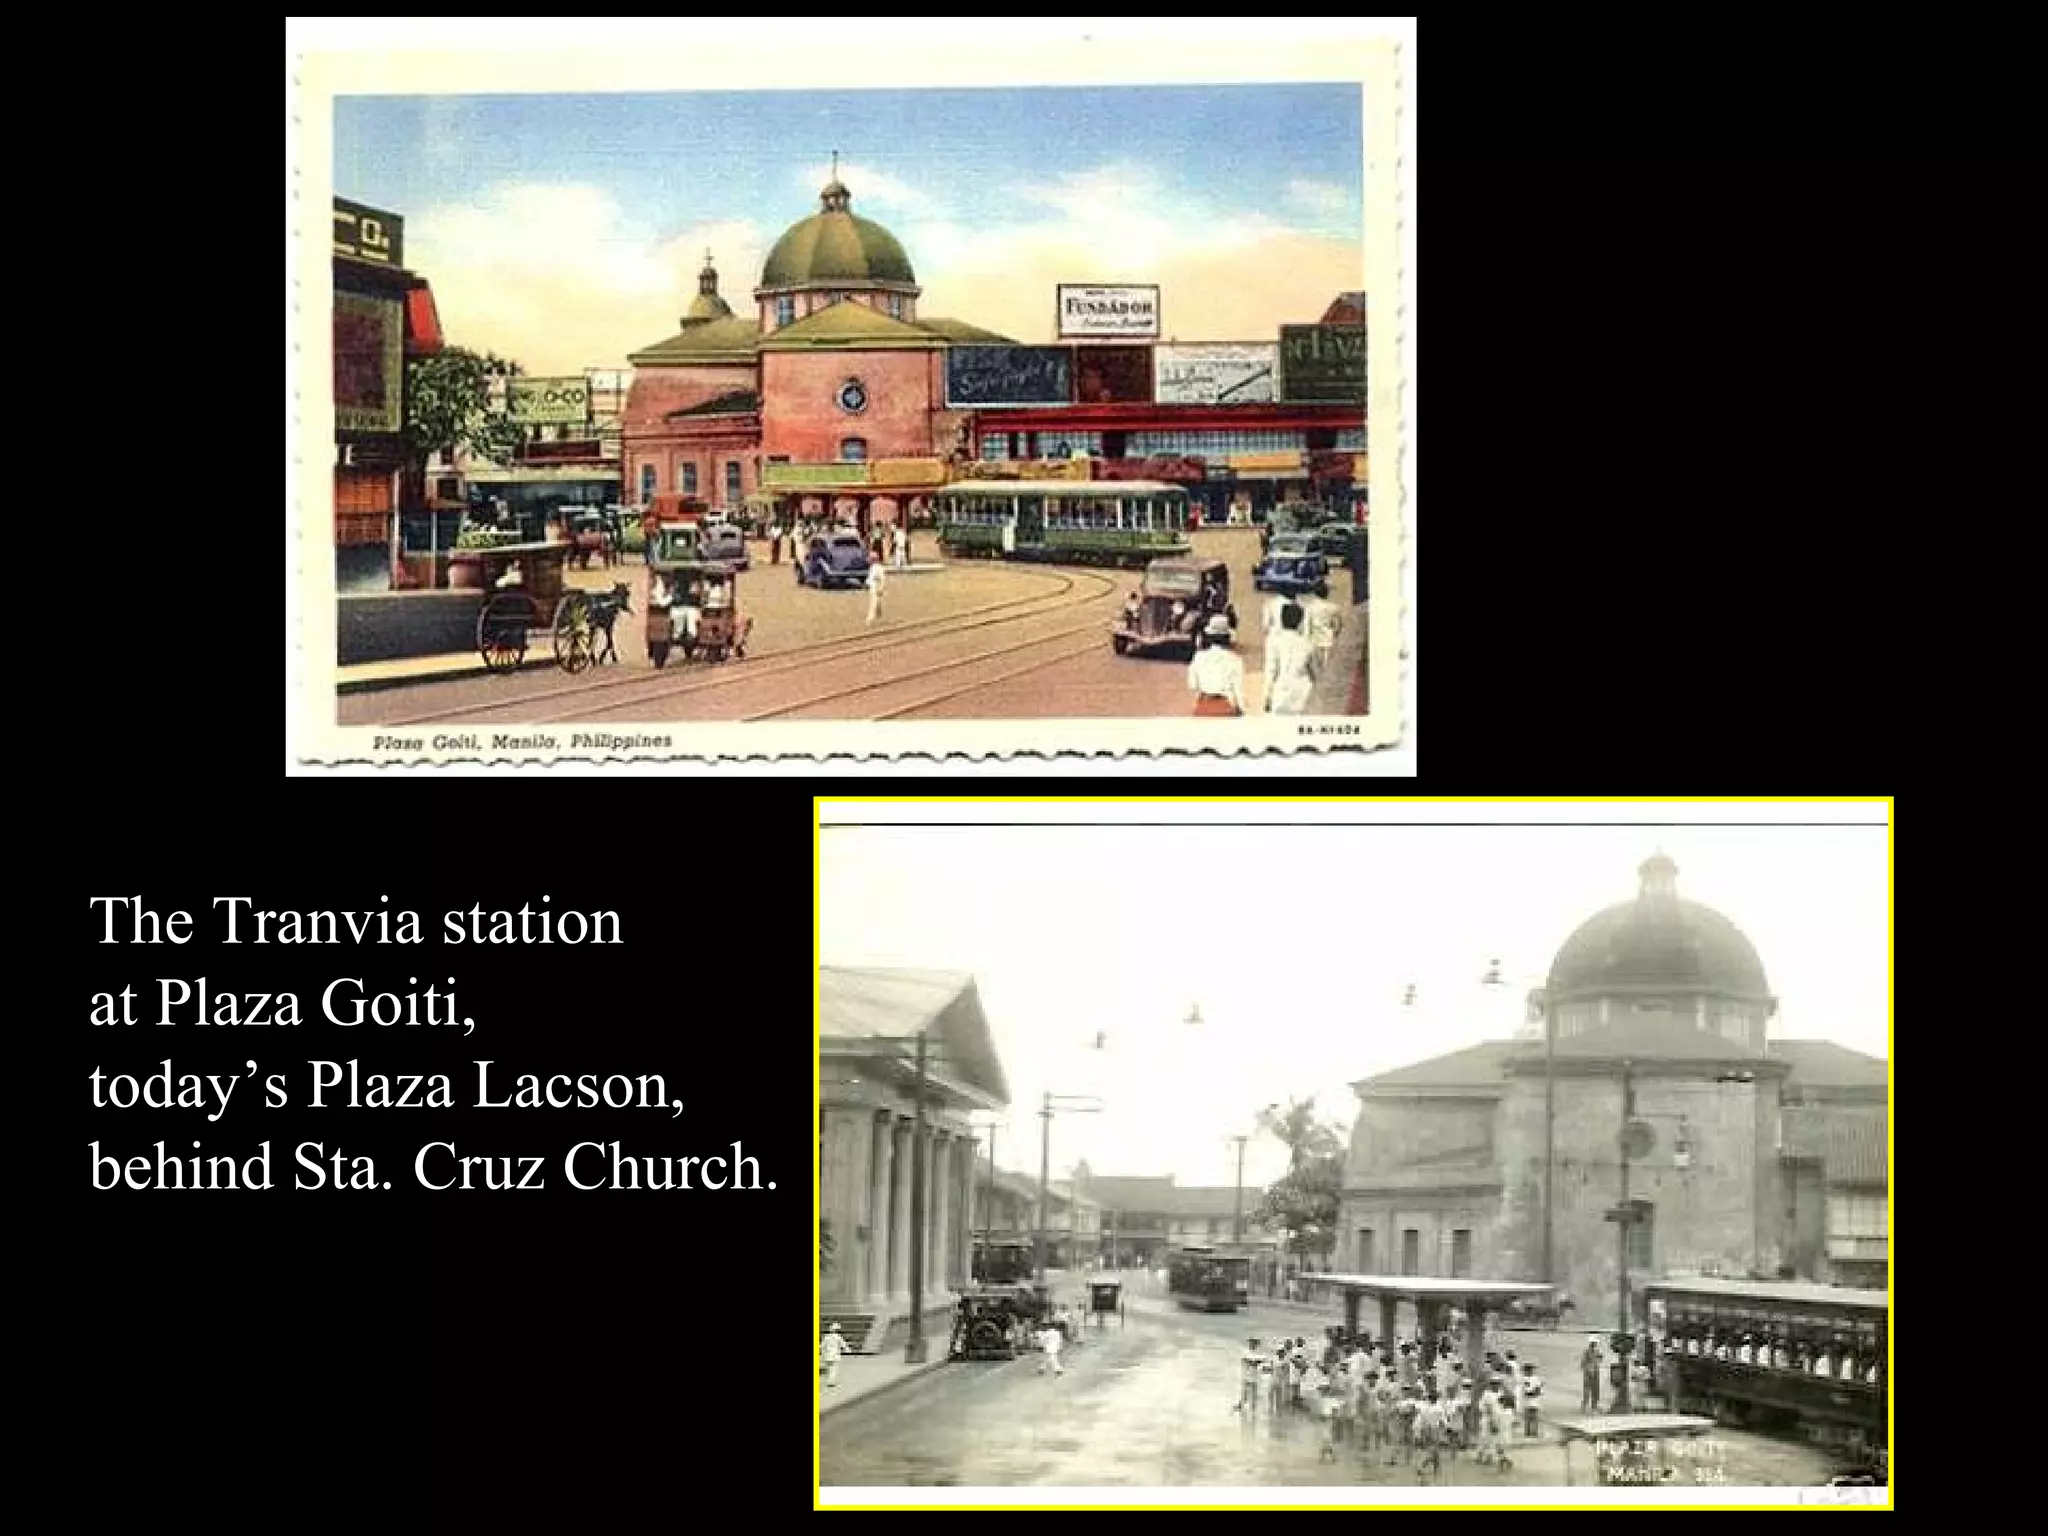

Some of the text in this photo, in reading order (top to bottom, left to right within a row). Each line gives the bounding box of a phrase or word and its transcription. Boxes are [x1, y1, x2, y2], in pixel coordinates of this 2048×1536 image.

[432, 734, 483, 751] Goiti,
[492, 734, 561, 751] Manila,
[570, 733, 673, 752] Philippines
